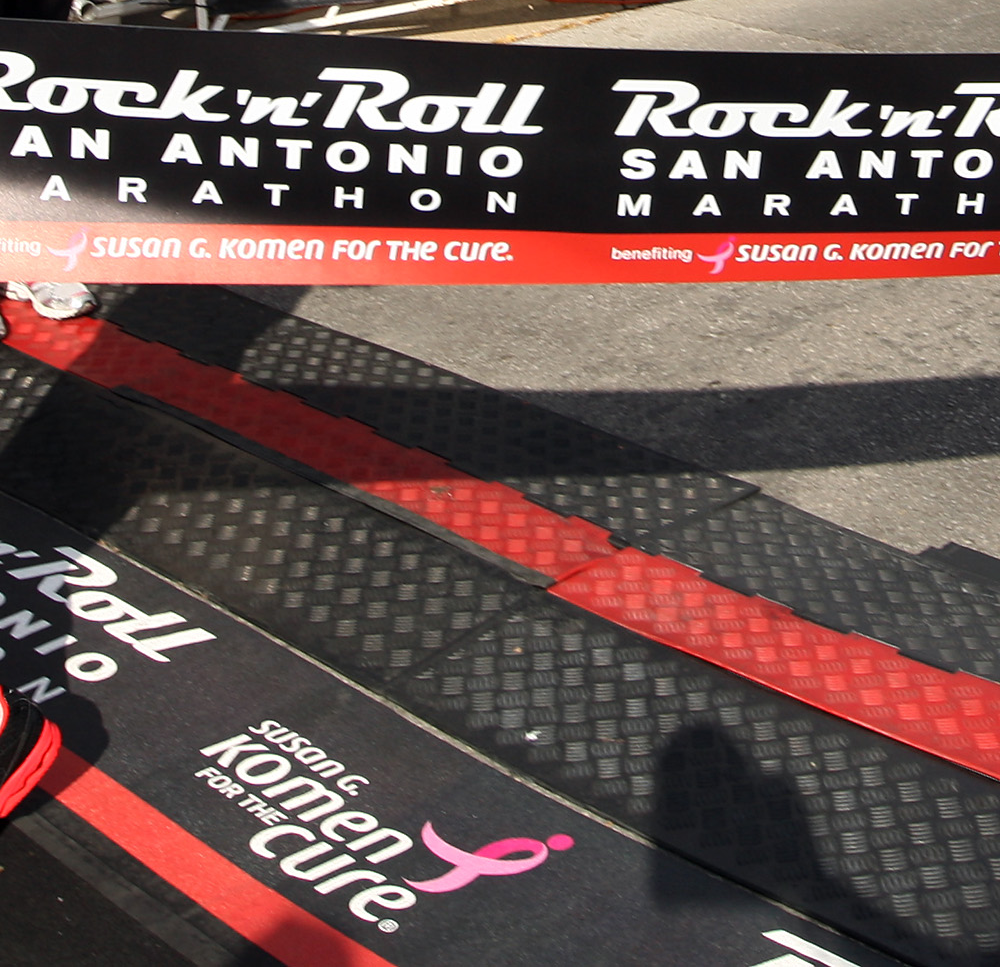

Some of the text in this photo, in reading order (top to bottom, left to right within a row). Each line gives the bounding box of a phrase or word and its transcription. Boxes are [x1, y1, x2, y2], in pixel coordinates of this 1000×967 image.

[317, 66, 546, 136] Roll
[610, 78, 873, 138] Rock
[160, 132, 524, 179] ANTONIO
[619, 147, 763, 181] SAN
[611, 246, 693, 263] benefiting
[7, 545, 218, 663] Roll
[194, 766, 290, 827] FOR THE
